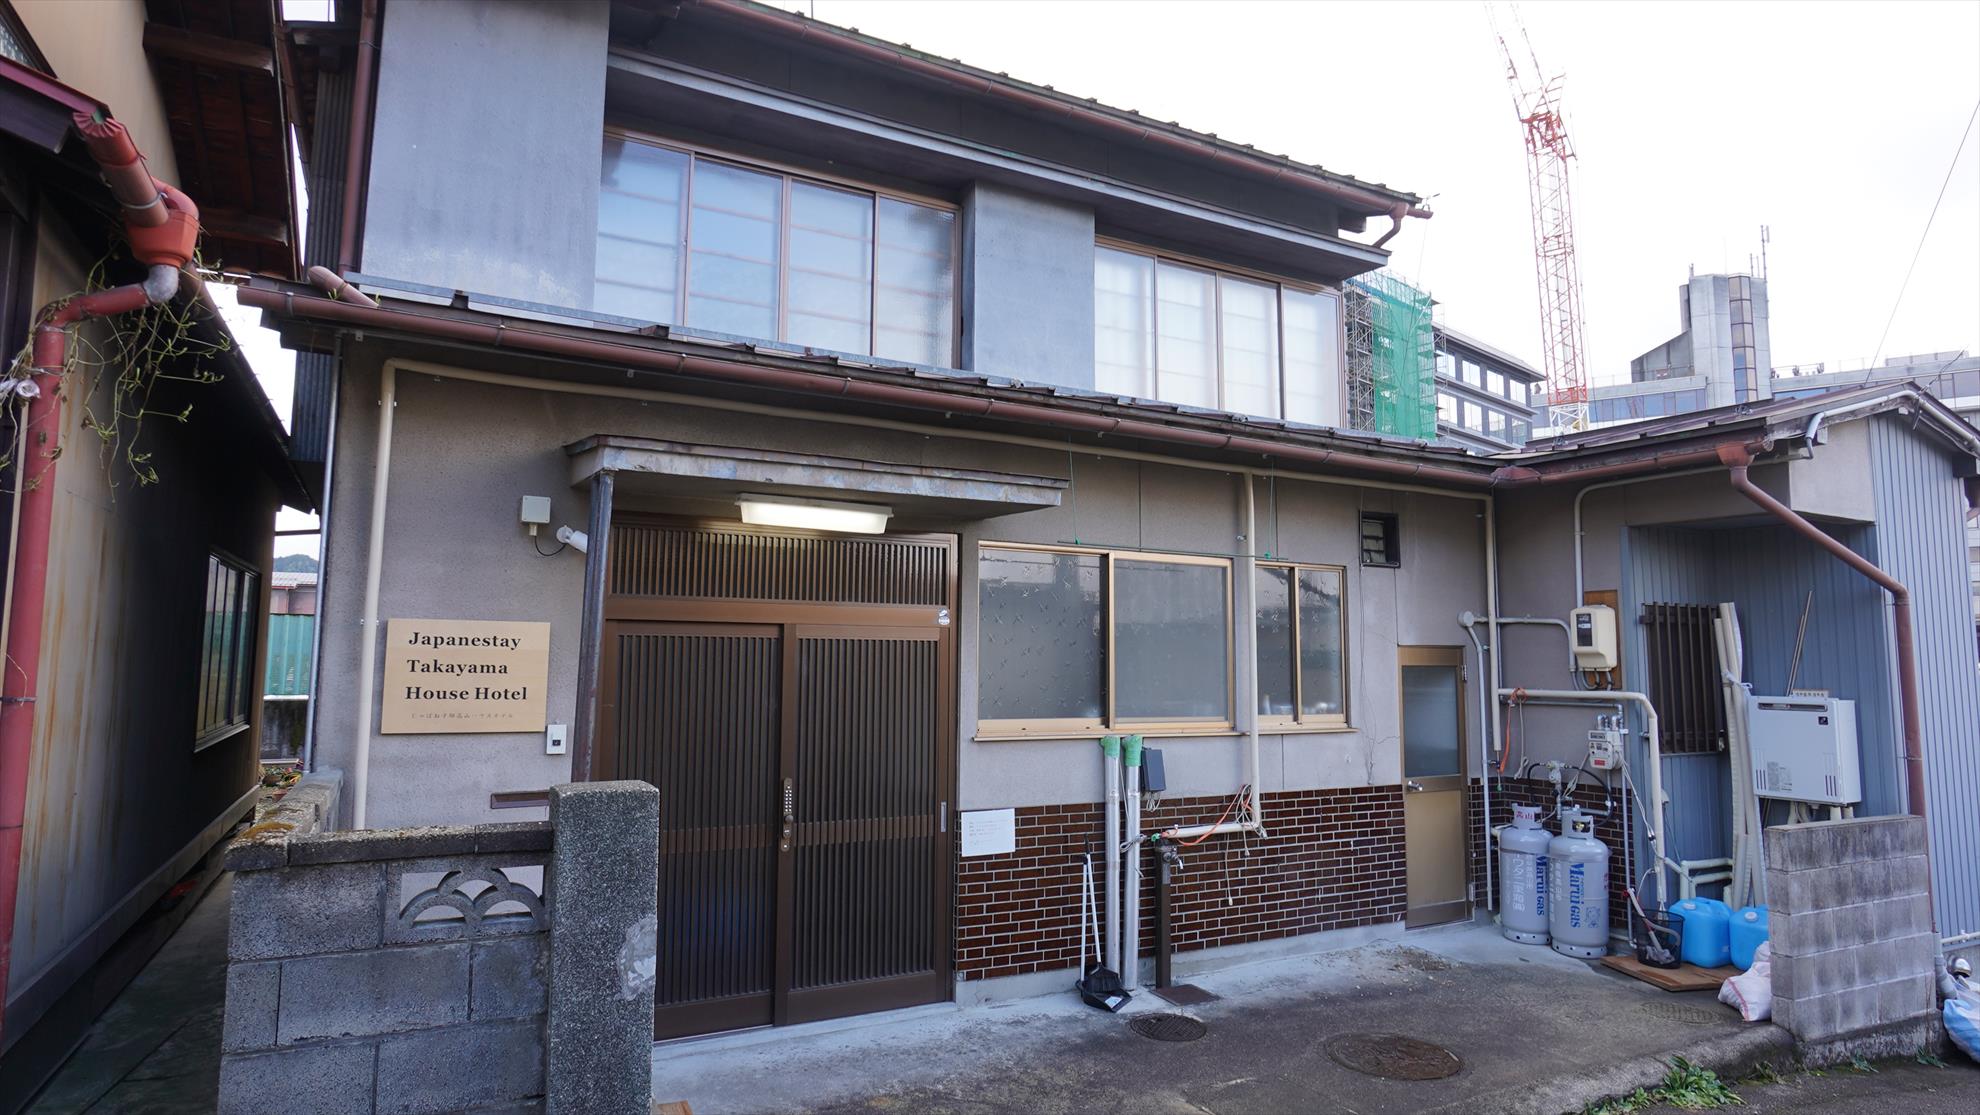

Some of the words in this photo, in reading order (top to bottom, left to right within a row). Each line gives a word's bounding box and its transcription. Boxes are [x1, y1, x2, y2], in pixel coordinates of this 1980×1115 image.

[409, 632, 521, 650] Japanestay
[407, 659, 508, 676] Takayama
[405, 686, 469, 700] House
[475, 687, 527, 700] Hotel
